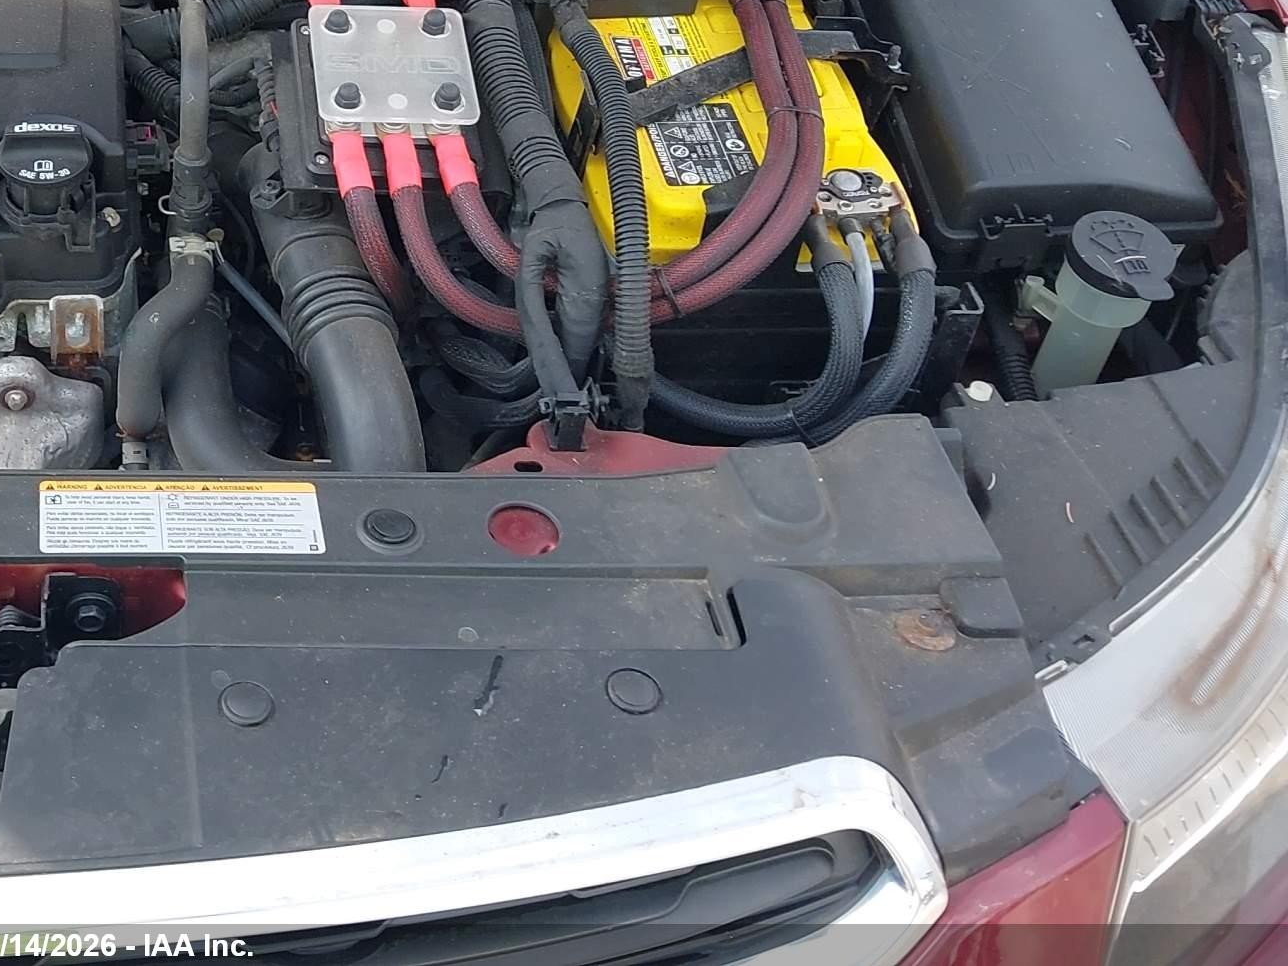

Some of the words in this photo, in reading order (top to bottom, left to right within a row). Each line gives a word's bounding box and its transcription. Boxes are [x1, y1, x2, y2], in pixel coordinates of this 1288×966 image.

[326, 54, 461, 75] SMD
[614, 38, 644, 78] OPTIMA
[14, 122, 78, 133] dexos
[18, 169, 37, 180] SAE
[39, 168, 71, 180] 5W-30
